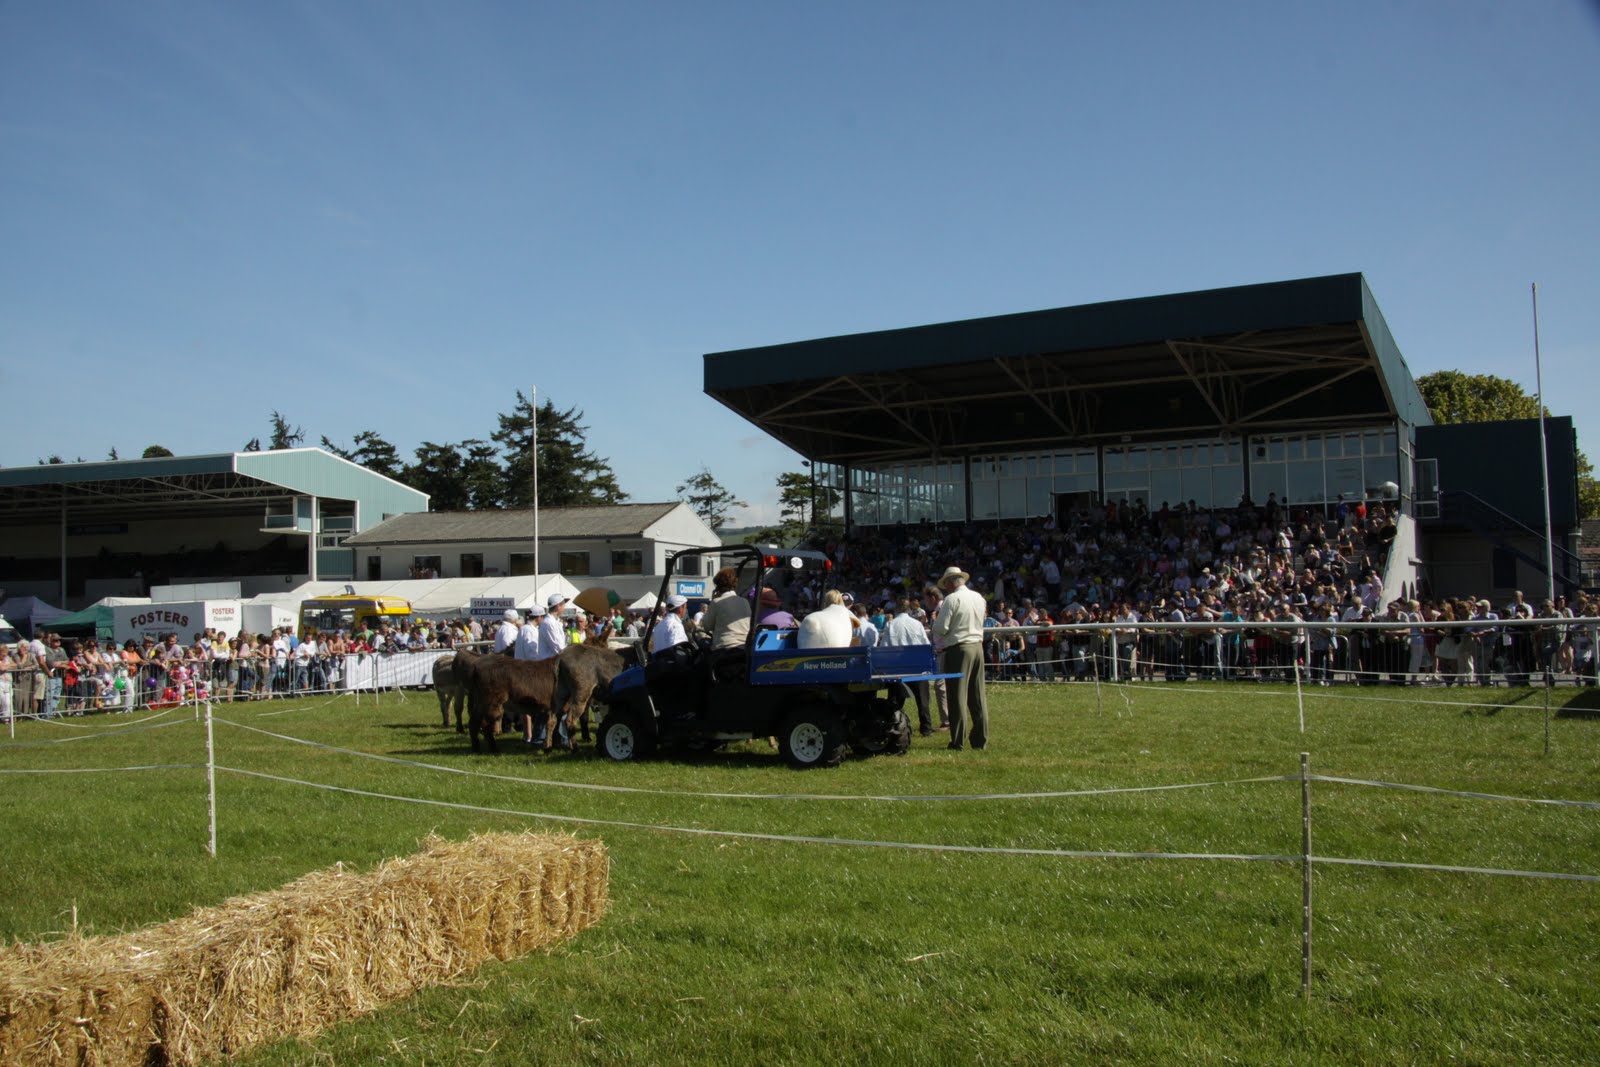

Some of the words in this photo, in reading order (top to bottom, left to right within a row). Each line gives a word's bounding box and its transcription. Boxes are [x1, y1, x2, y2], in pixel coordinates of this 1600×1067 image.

[212, 607, 235, 615] FOSTERS
[130, 610, 189, 629] FOSTERS
[820, 661, 847, 669] Holland
